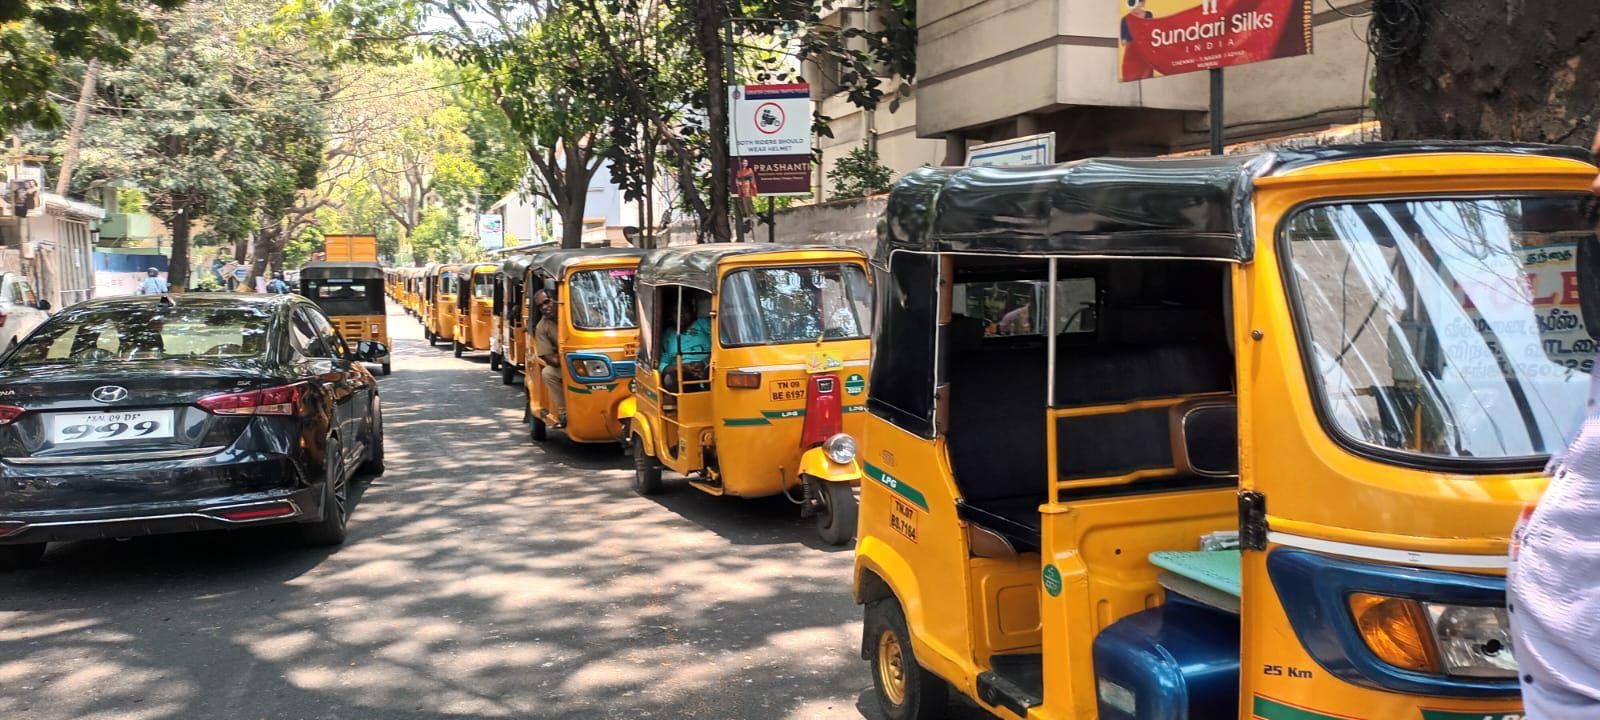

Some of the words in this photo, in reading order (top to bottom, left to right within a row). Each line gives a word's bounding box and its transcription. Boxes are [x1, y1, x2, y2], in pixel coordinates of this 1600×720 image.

[1151, 17, 1225, 47] Sundari
[1231, 10, 1274, 34] Silks
[1185, 38, 1236, 53] INDIA
[772, 392, 784, 400] BE
[785, 390, 805, 399] 6197
[109, 414, 121, 422] 09
[781, 410, 799, 418] LPG
[881, 473, 897, 488] LPG
[1263, 664, 1283, 676] 25
[1287, 666, 1313, 679] Km
